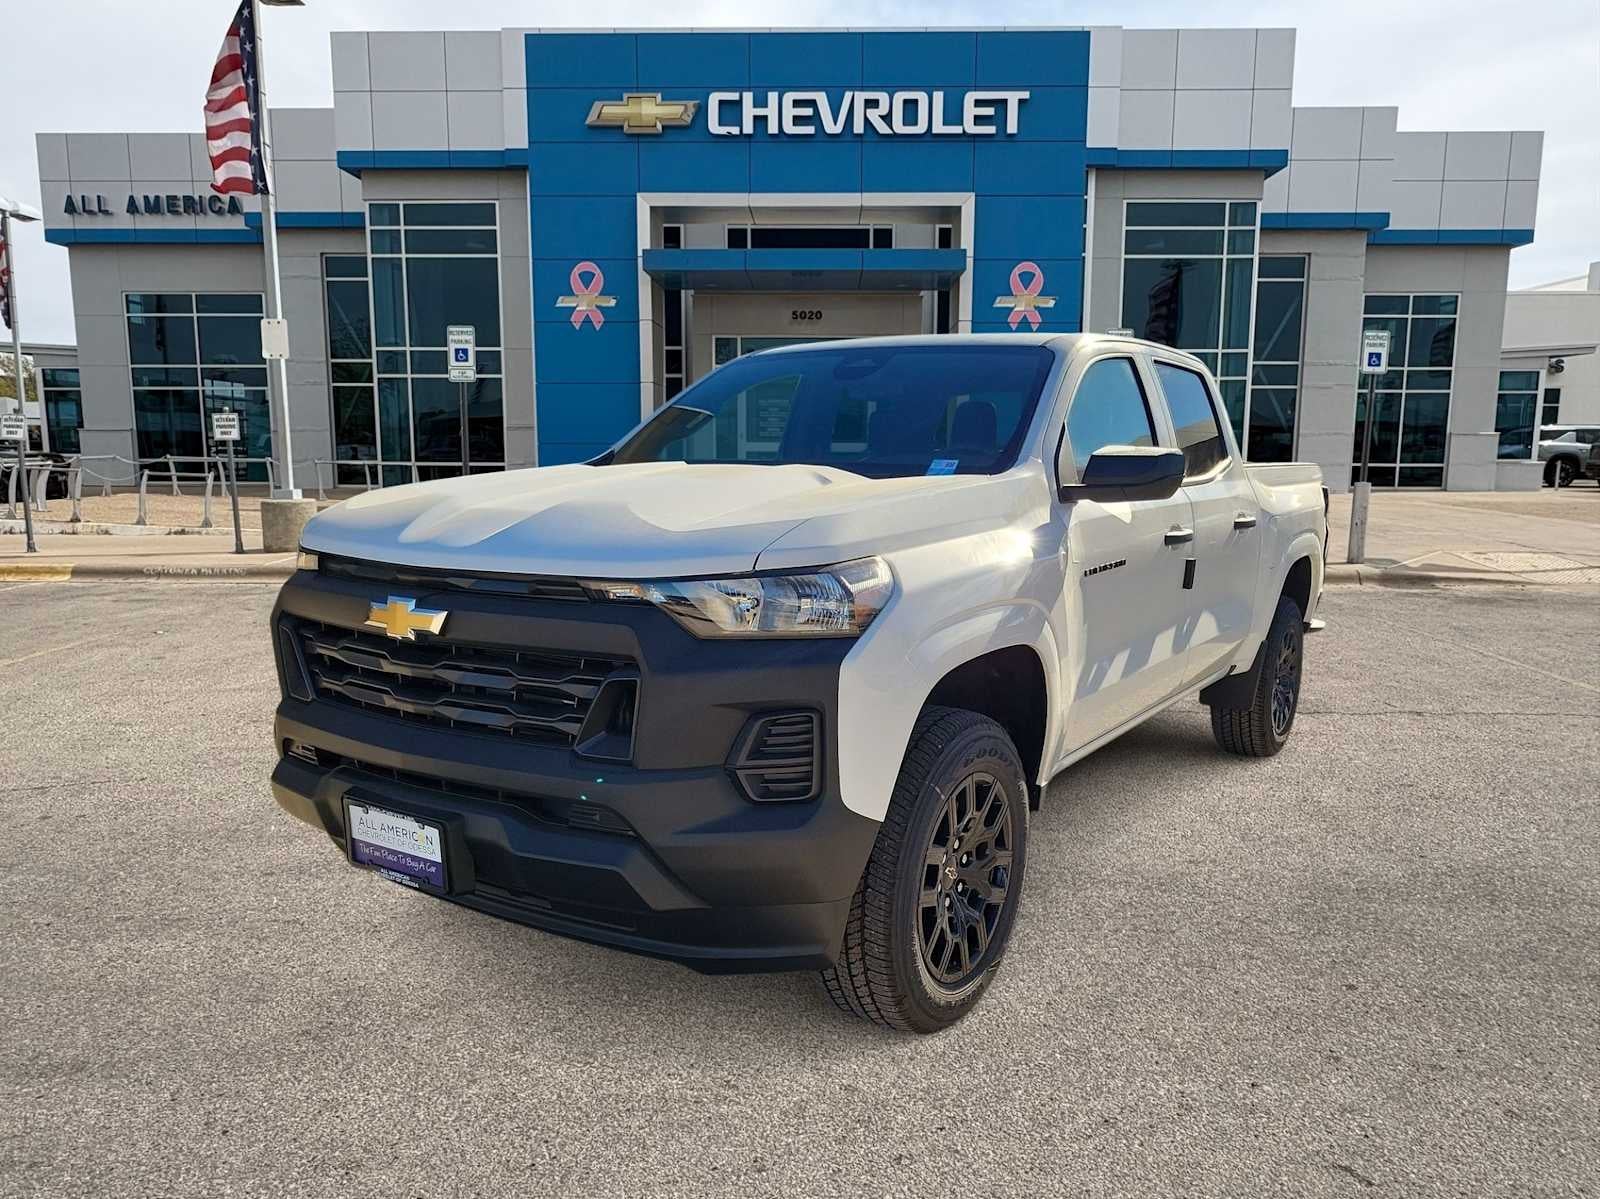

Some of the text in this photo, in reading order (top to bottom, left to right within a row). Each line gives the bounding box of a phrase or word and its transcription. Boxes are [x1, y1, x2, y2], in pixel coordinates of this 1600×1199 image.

[708, 91, 1029, 135] CHEVROLET
[64, 195, 110, 215] ALL
[791, 310, 822, 320] 5020
[359, 817, 377, 831] ALL
[360, 843, 370, 855] The
